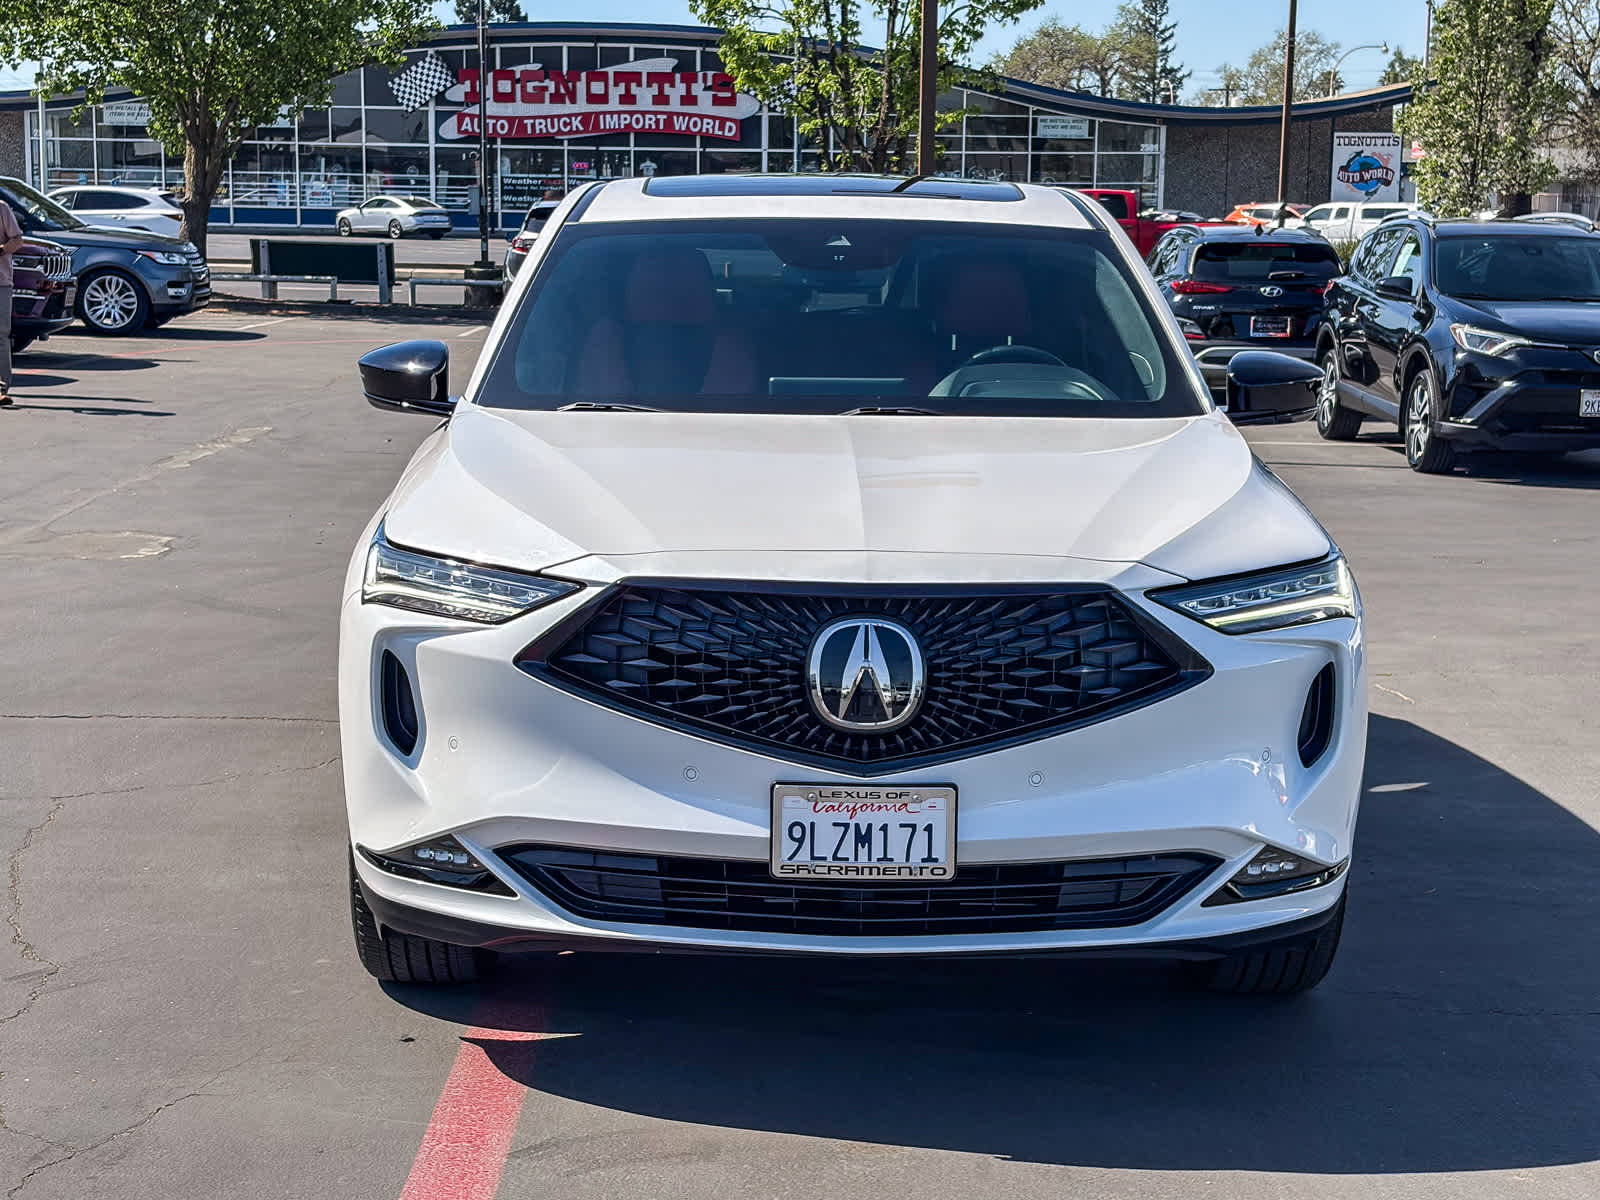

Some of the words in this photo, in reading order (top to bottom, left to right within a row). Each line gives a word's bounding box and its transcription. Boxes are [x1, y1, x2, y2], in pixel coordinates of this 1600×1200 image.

[458, 69, 736, 107] TOGNOTTI'S
[524, 116, 584, 135] TRUCK
[599, 114, 667, 130] IMPORT
[673, 115, 736, 137] WORLD
[1336, 135, 1400, 146] TOGNOTTI'S
[1338, 171, 1360, 182] AUTO
[1362, 168, 1393, 182] WORLD
[819, 790, 881, 800] LEXUS
[886, 791, 911, 799] OF
[812, 801, 921, 820] California
[787, 821, 939, 863] 9LZM171
[779, 864, 947, 877] SACRAMENTO
